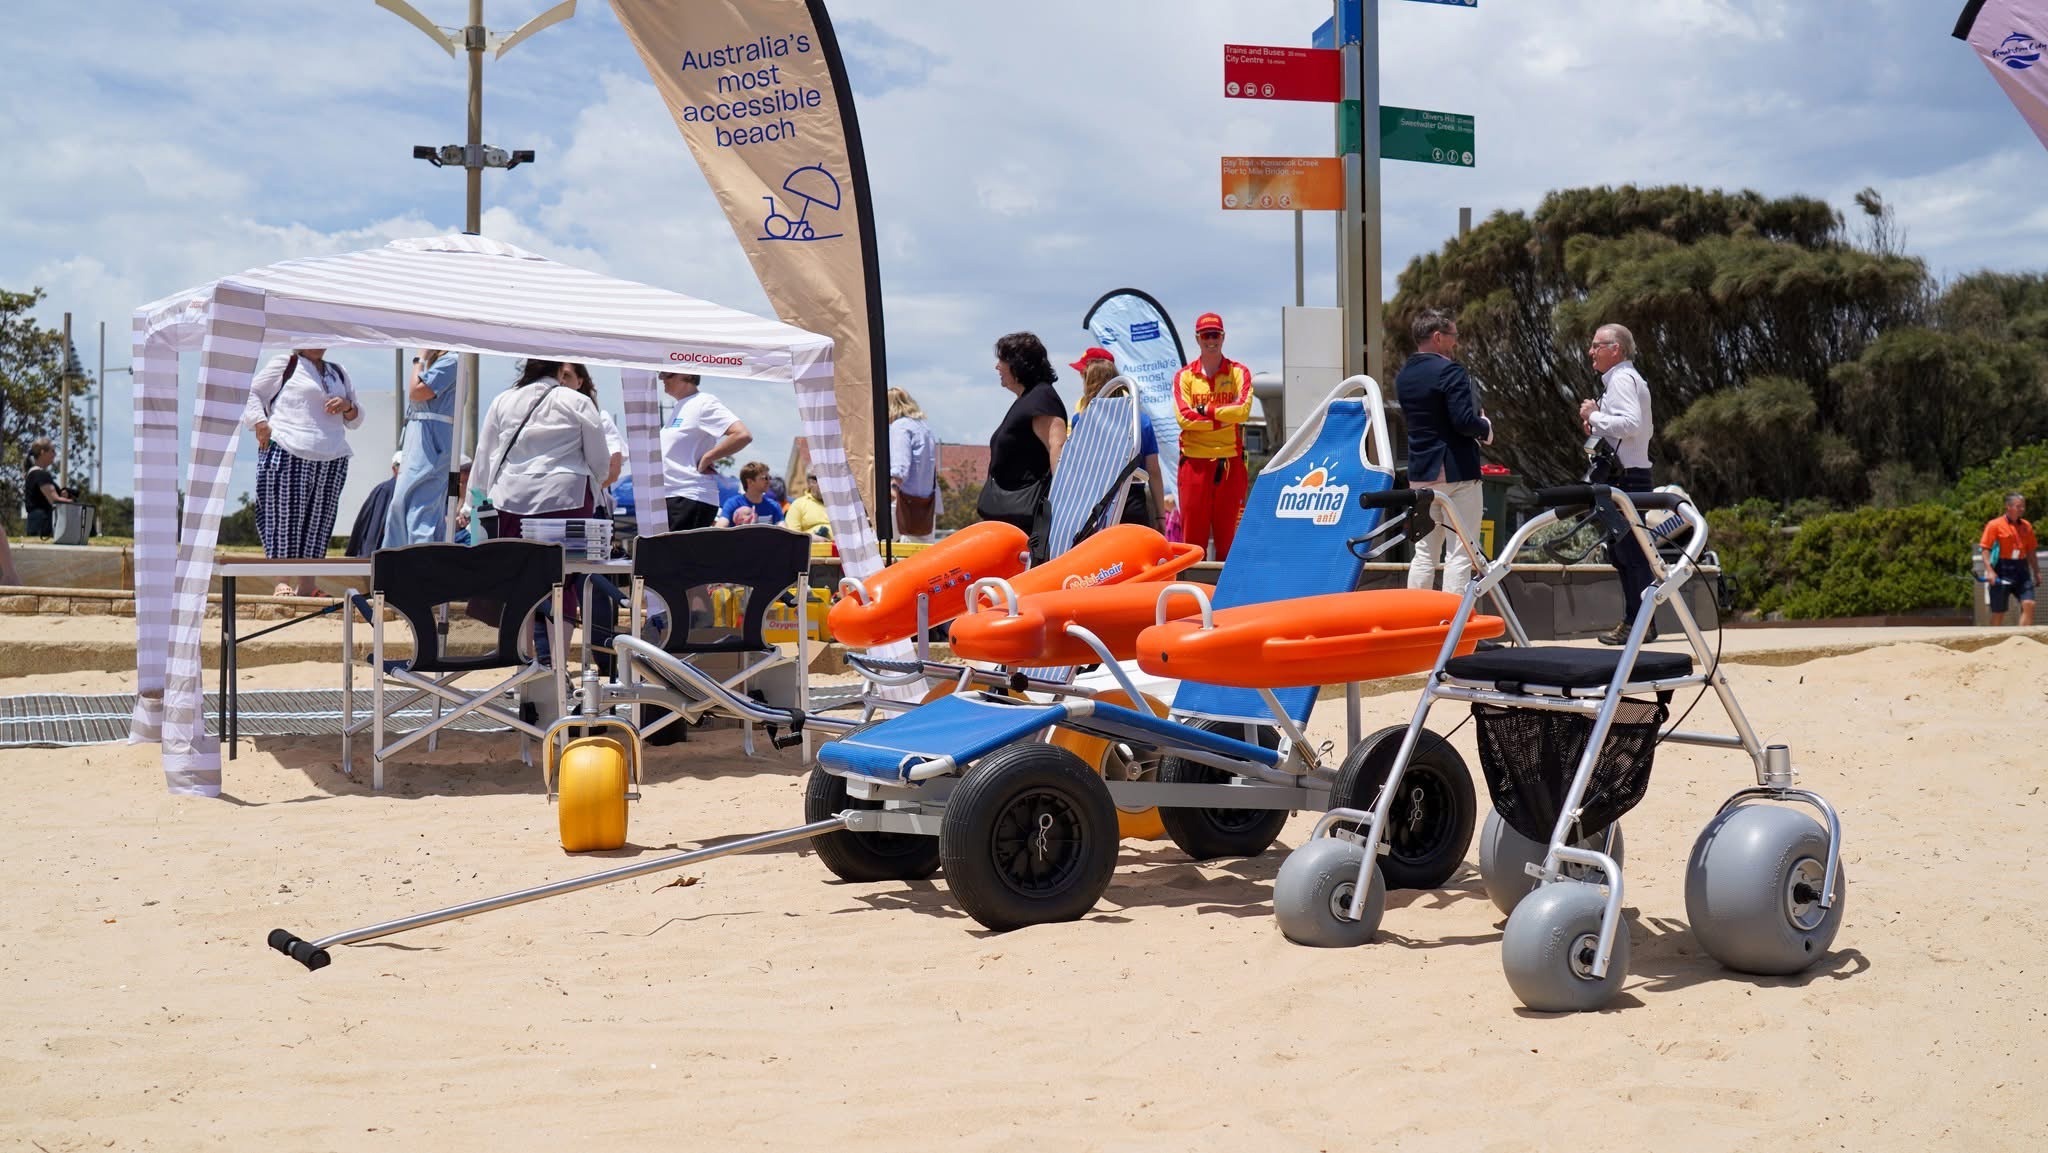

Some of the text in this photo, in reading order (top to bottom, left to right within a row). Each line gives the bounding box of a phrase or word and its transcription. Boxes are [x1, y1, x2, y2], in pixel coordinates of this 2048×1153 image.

[681, 34, 810, 71] Australia’s
[1225, 46, 1247, 55] Trains
[1249, 47, 1261, 55] and
[1263, 48, 1285, 56] Buses
[1225, 54, 1239, 64] City
[1240, 55, 1264, 64] Centre
[717, 64, 781, 94] most
[683, 87, 821, 122] accessible
[1422, 112, 1443, 121] Olivers
[1444, 114, 1455, 122] Hill
[1400, 118, 1436, 129] Sweetwater
[1437, 122, 1456, 131] Creek
[716, 117, 795, 147] beach
[1223, 159, 1236, 167] Bay
[1238, 158, 1254, 166] Trail
[1297, 159, 1319, 167] Creek
[1223, 167, 1238, 175] Pier
[1248, 167, 1264, 175] Mile
[1265, 167, 1289, 176] Bridge
[1122, 359, 1177, 373] Australia's
[1137, 372, 1165, 383] most
[1143, 393, 1171, 404] each
[1279, 487, 1344, 510] marina
[1316, 512, 1337, 523] anfi
[1650, 514, 1685, 541] PUMA
[769, 621, 799, 630] Oxygen
